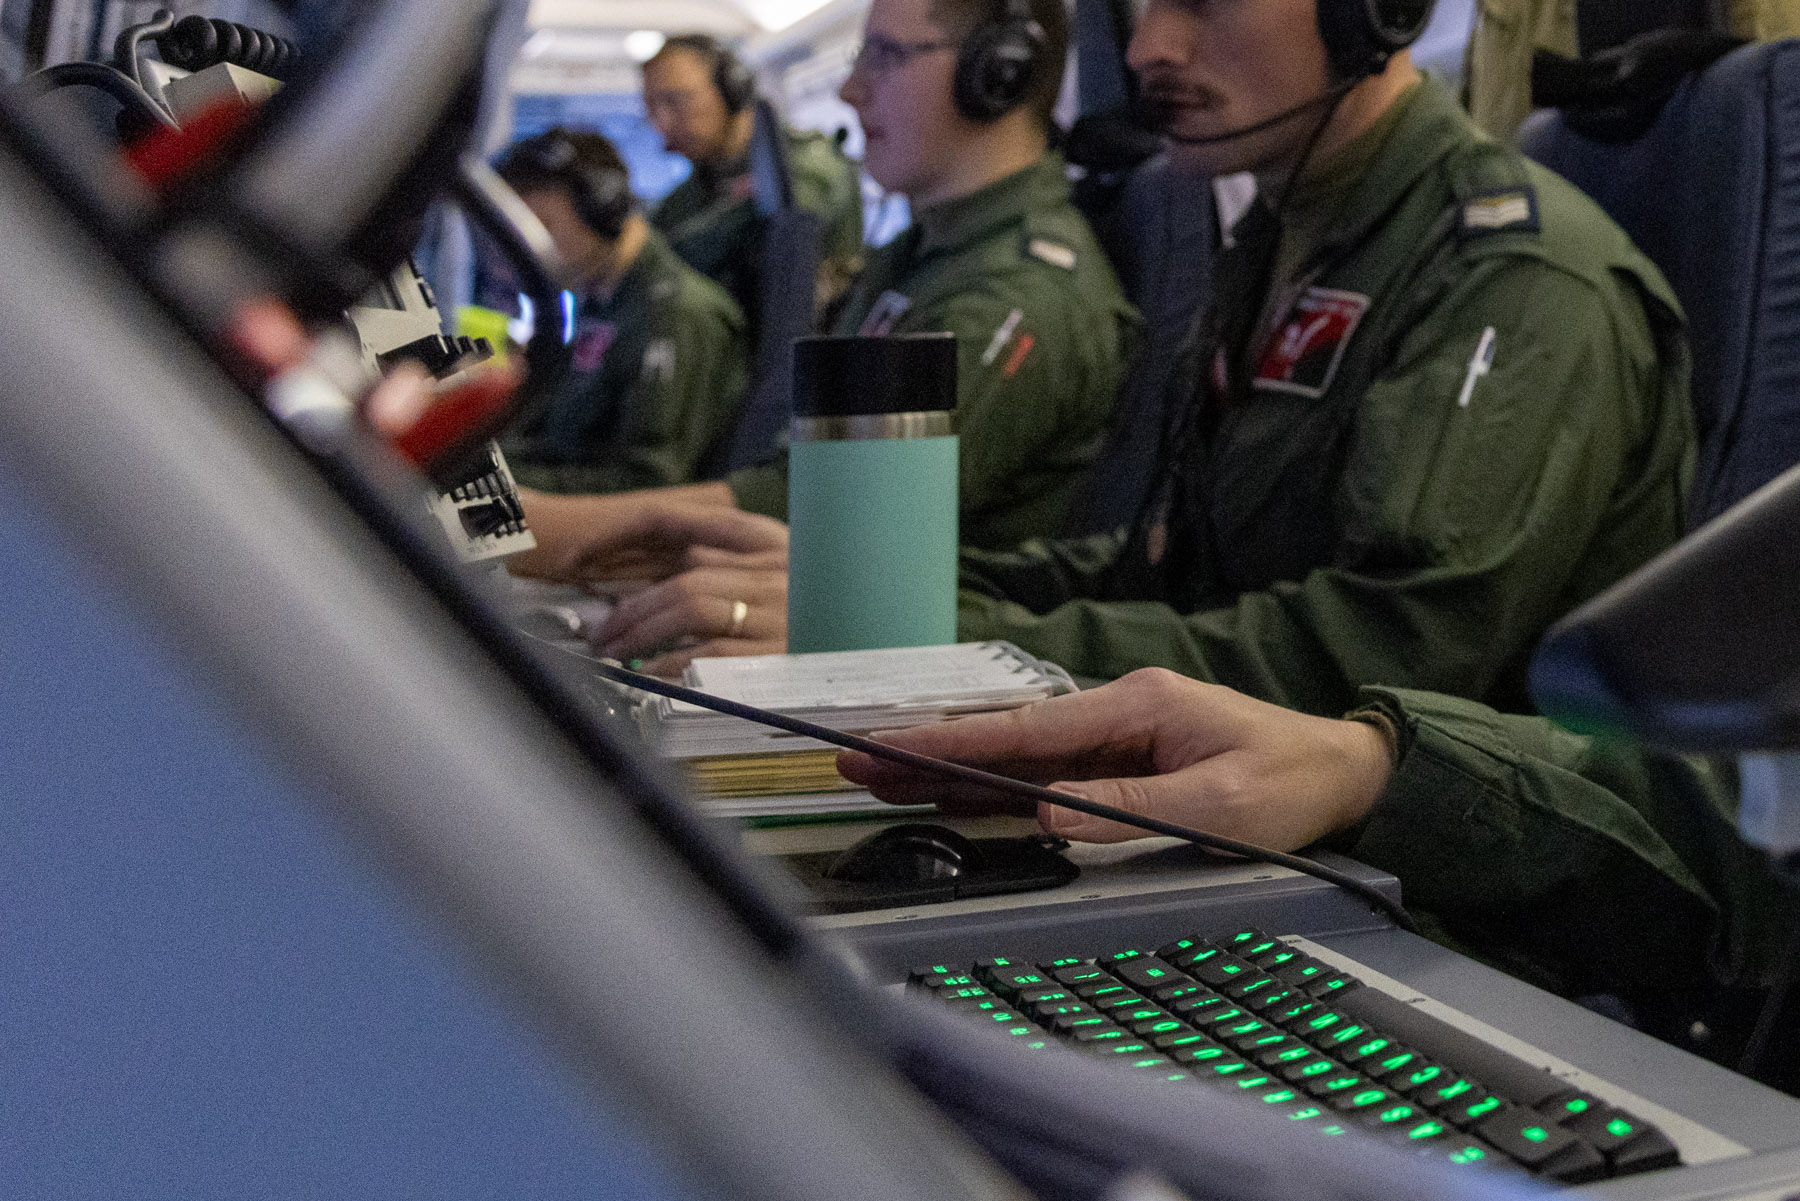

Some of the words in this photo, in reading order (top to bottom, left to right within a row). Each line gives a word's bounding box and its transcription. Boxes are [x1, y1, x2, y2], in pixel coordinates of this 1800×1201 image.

[1214, 1008, 1241, 1021] L
[1232, 1020, 1262, 1034] K
[1333, 1024, 1363, 1042] N
[1358, 1038, 1389, 1056] B
[1381, 1052, 1413, 1071] V
[1409, 1065, 1441, 1084] C
[1437, 1079, 1472, 1100] X
